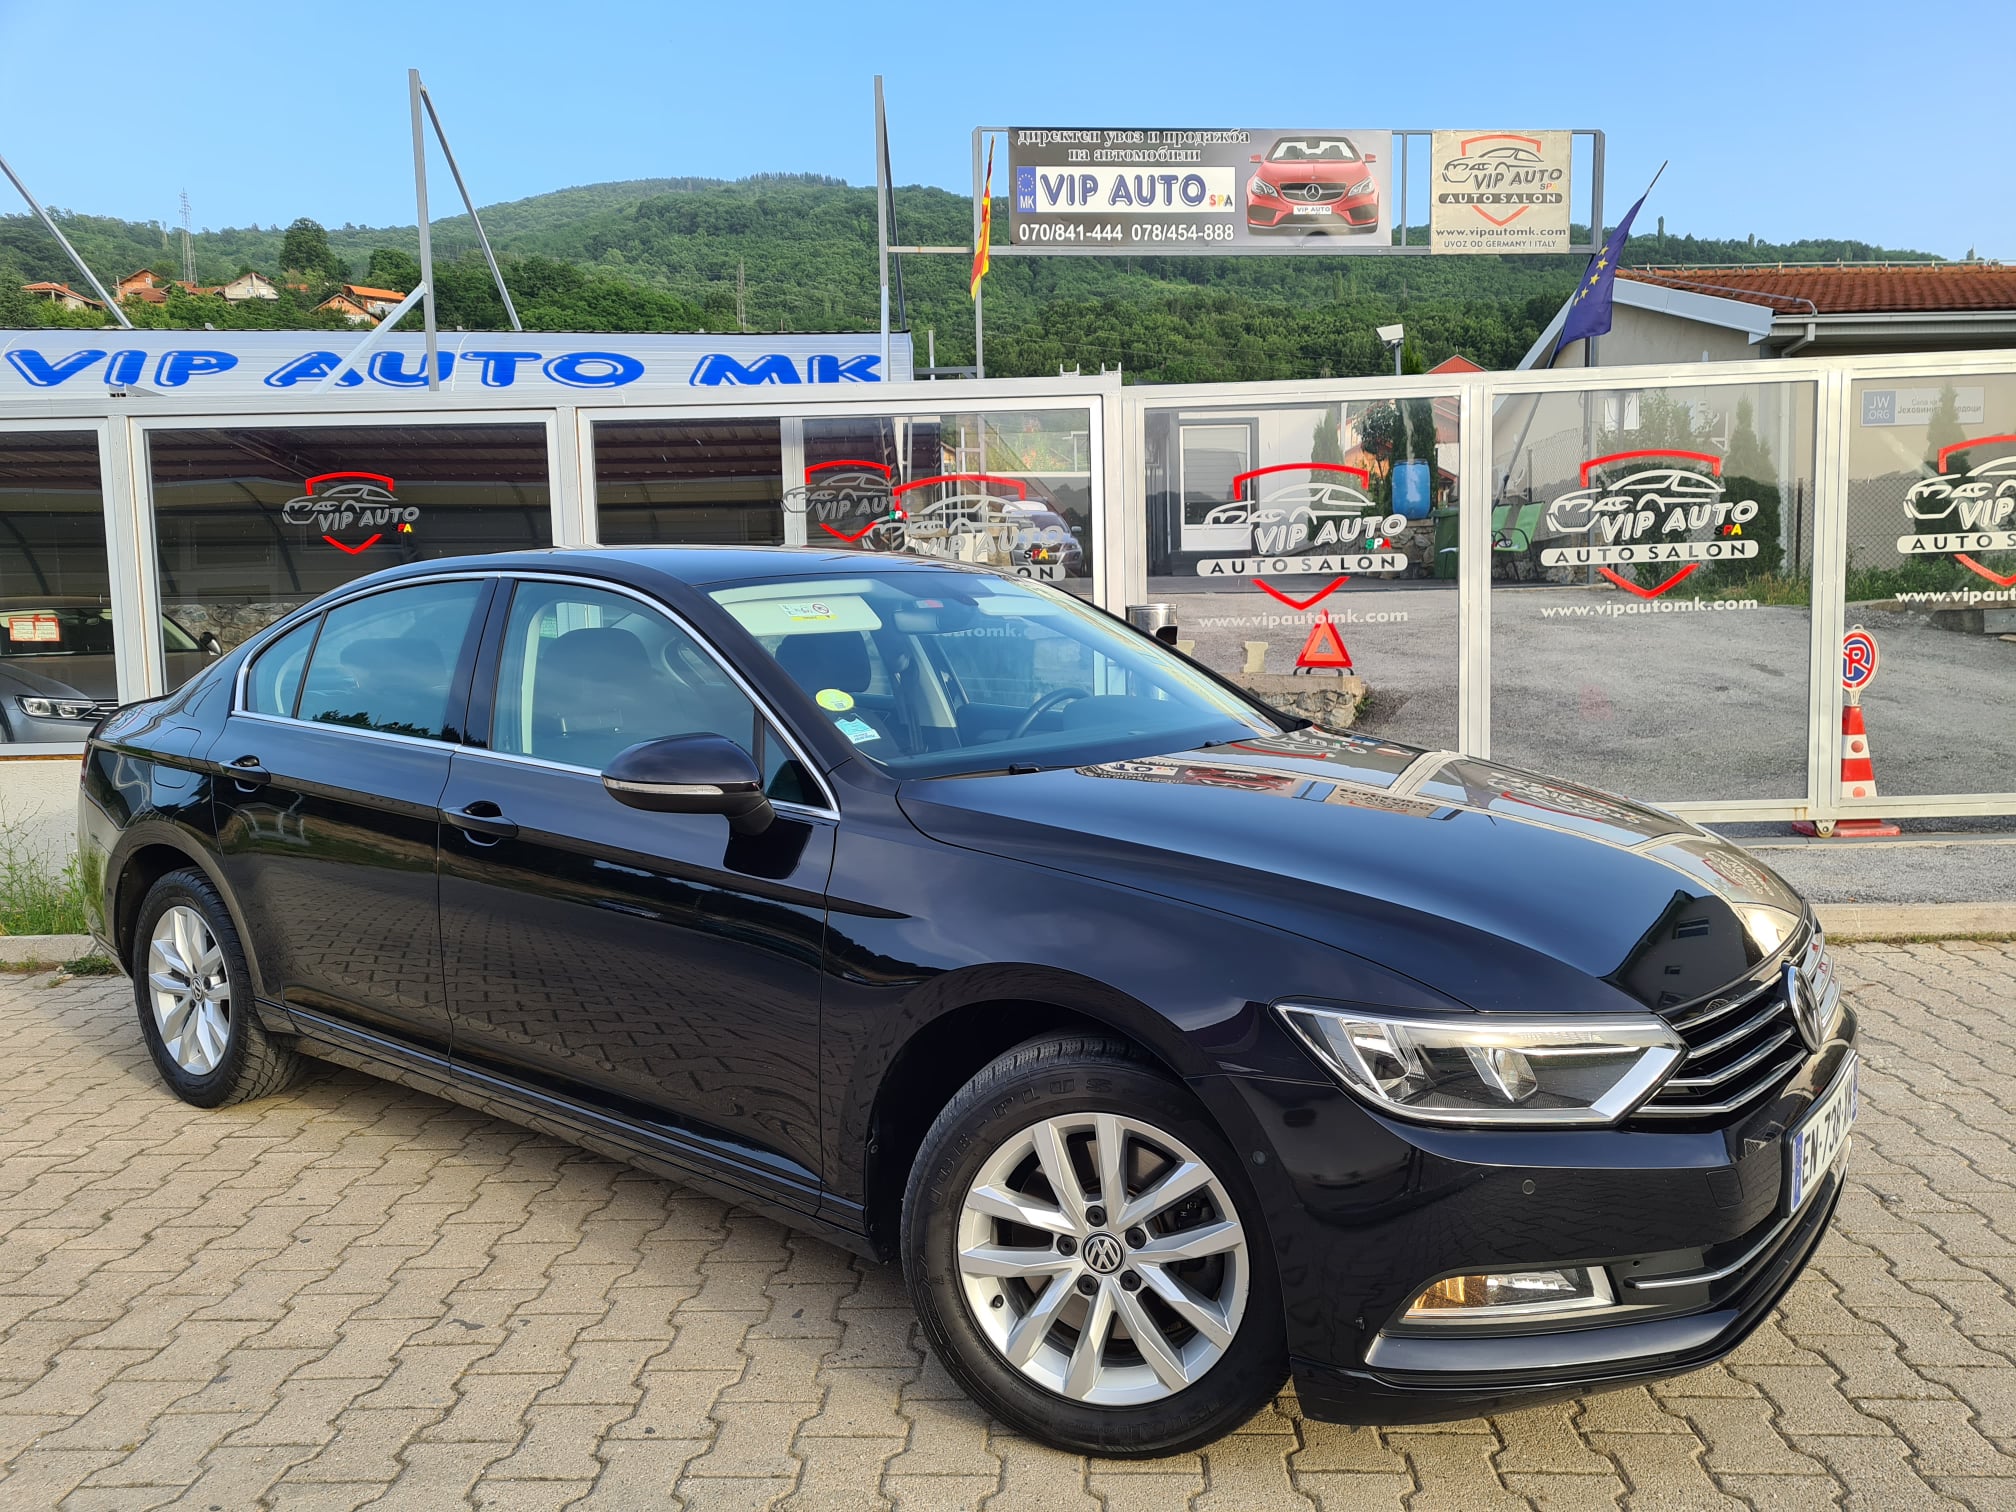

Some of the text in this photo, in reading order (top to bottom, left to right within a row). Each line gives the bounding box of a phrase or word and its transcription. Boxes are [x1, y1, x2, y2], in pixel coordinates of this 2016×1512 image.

[1017, 128, 1251, 148] директен увоз и продажба
[1067, 146, 1201, 161] на автомобили
[1473, 168, 1563, 191] VIP AUTO
[1039, 173, 1233, 208] VIP AUTO SPA
[1445, 193, 1556, 203] AUTO SALON
[1019, 195, 1035, 209] MK
[1018, 223, 1235, 241] 070/841-444 078/454-888
[1435, 226, 1567, 238] www.vipautomk.com
[1443, 240, 1468, 248] UVOZ
[1470, 240, 1483, 248] OD
[1485, 240, 1528, 248] GERMANY
[1534, 240, 1557, 248] ITALY
[4, 349, 882, 389] VIP AUTO MK
[317, 506, 420, 532] VIP AUTO
[815, 500, 851, 521] VIP
[888, 510, 909, 521] SPA
[1958, 497, 2015, 530] VIP
[1600, 499, 1759, 543] VIP AUTO
[1713, 523, 1743, 536] SPA
[914, 525, 1065, 560] VIP AUTO
[1254, 514, 1408, 555] VIP AUTO
[1364, 537, 1393, 550] SPA
[1911, 534, 1993, 551] AUTO
[1023, 548, 1049, 561] SPA
[1554, 542, 1745, 564] AUTO SALON
[1210, 556, 1395, 575] AUTO SALON
[1540, 597, 1758, 618] www.vipautomk.com
[1198, 608, 1409, 629] www.vipautomk.com
